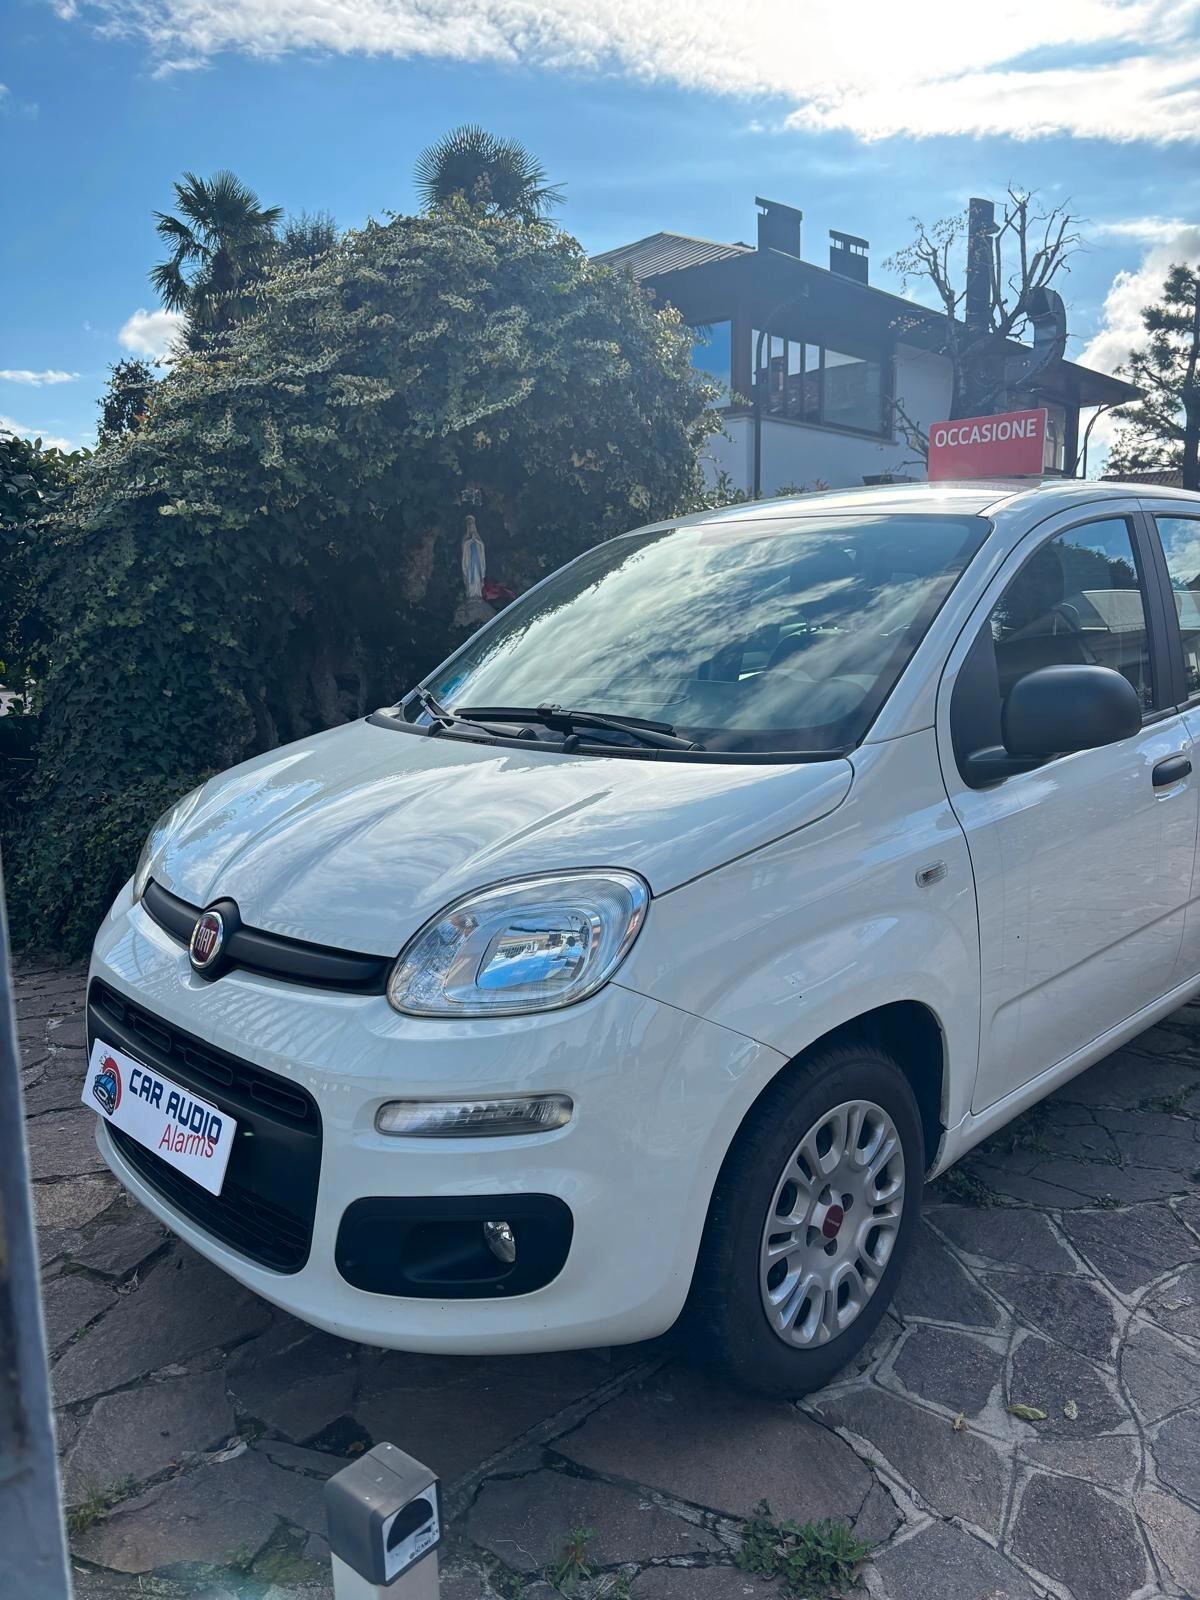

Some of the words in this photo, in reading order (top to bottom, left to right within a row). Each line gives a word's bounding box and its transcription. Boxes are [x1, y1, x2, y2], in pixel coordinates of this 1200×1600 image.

[935, 418, 1037, 448] OCCASIONE
[195, 926, 216, 954] FIAT
[129, 1068, 164, 1109] CAR
[166, 1090, 223, 1146] AUDIO
[158, 1123, 216, 1159] Alarms
